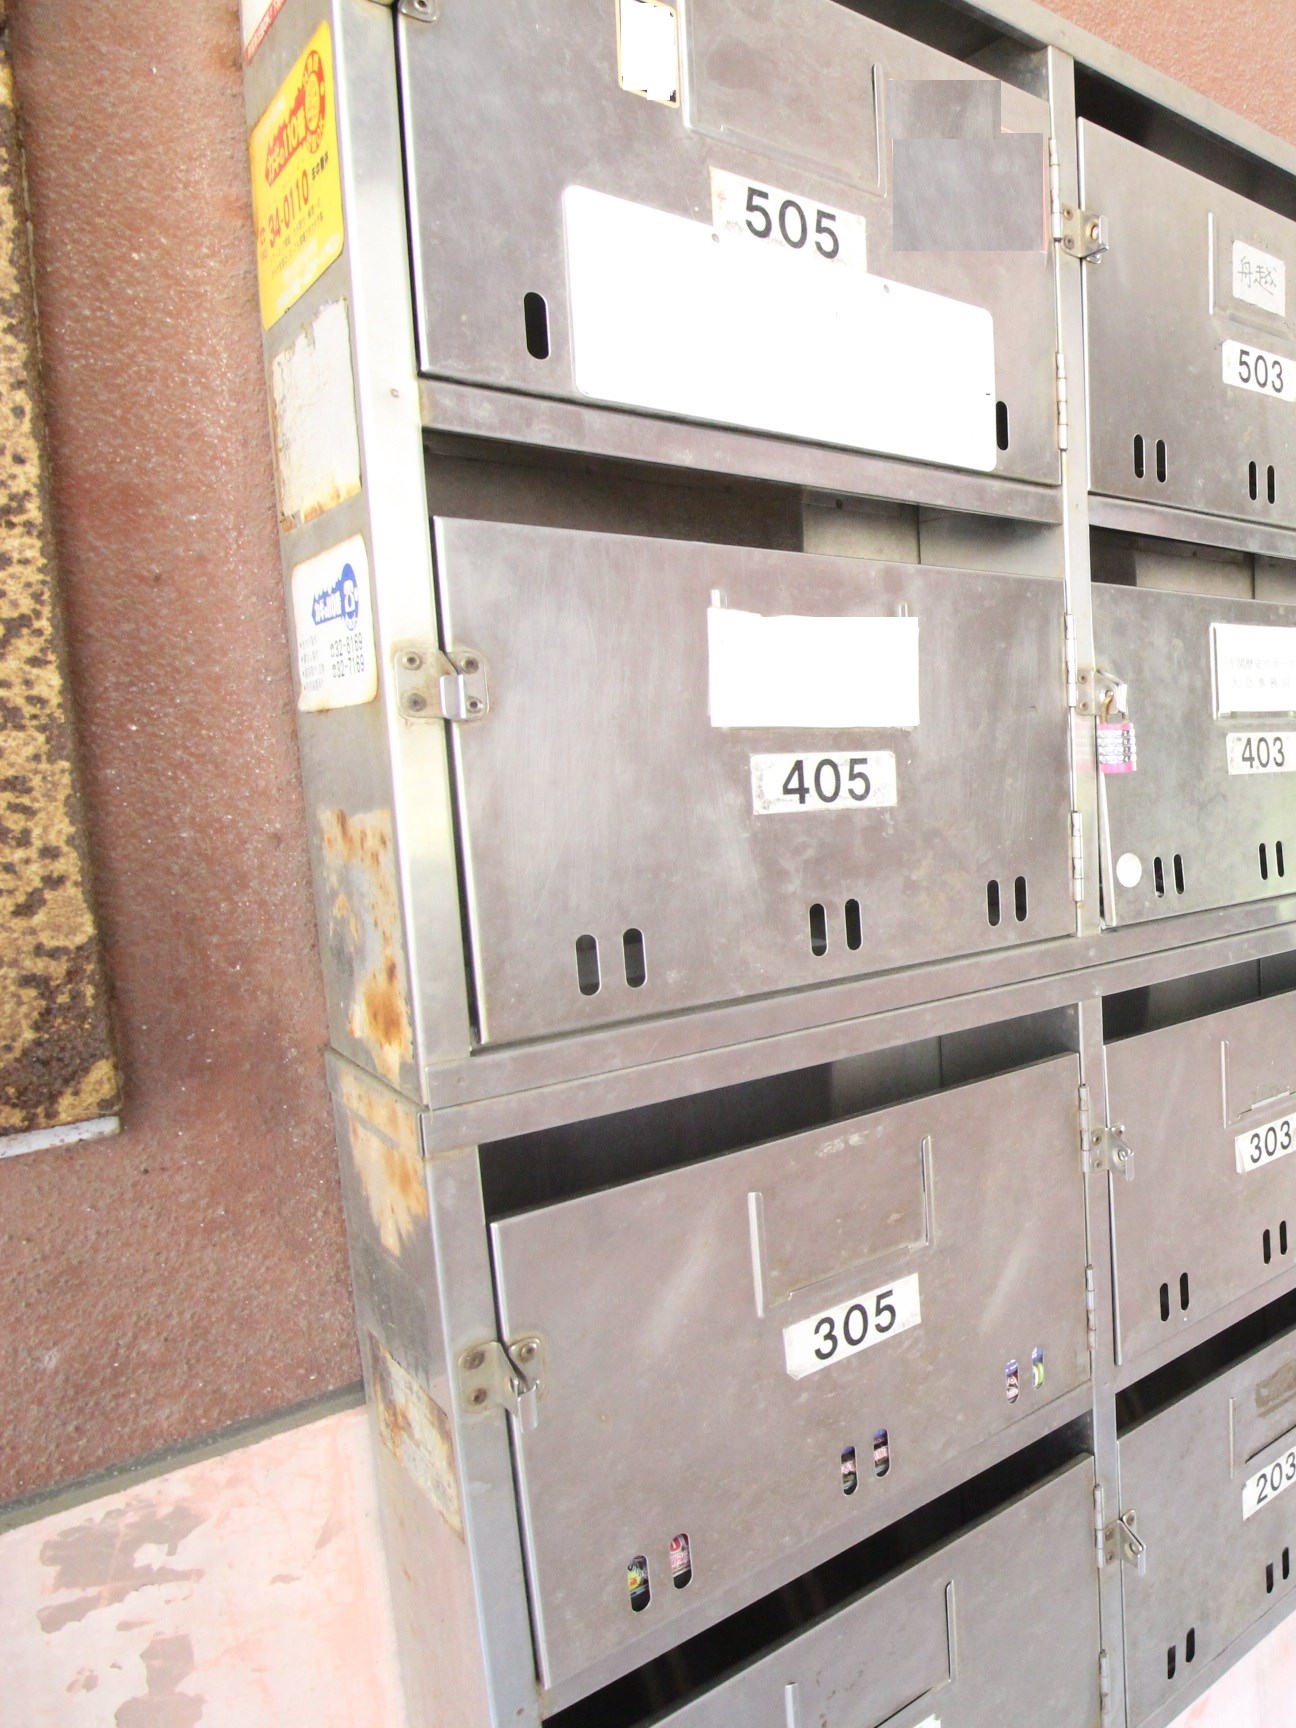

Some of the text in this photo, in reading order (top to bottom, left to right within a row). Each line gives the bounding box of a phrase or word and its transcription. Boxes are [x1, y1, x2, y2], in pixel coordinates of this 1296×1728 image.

[268, 169, 309, 248] 34-0110
[746, 187, 840, 260] 505
[1238, 349, 1284, 393] 503
[1241, 737, 1285, 768] 403
[782, 758, 871, 804] 405
[1250, 1121, 1292, 1163] 303
[814, 1290, 896, 1361] 305
[1256, 1452, 1296, 1504] 203
